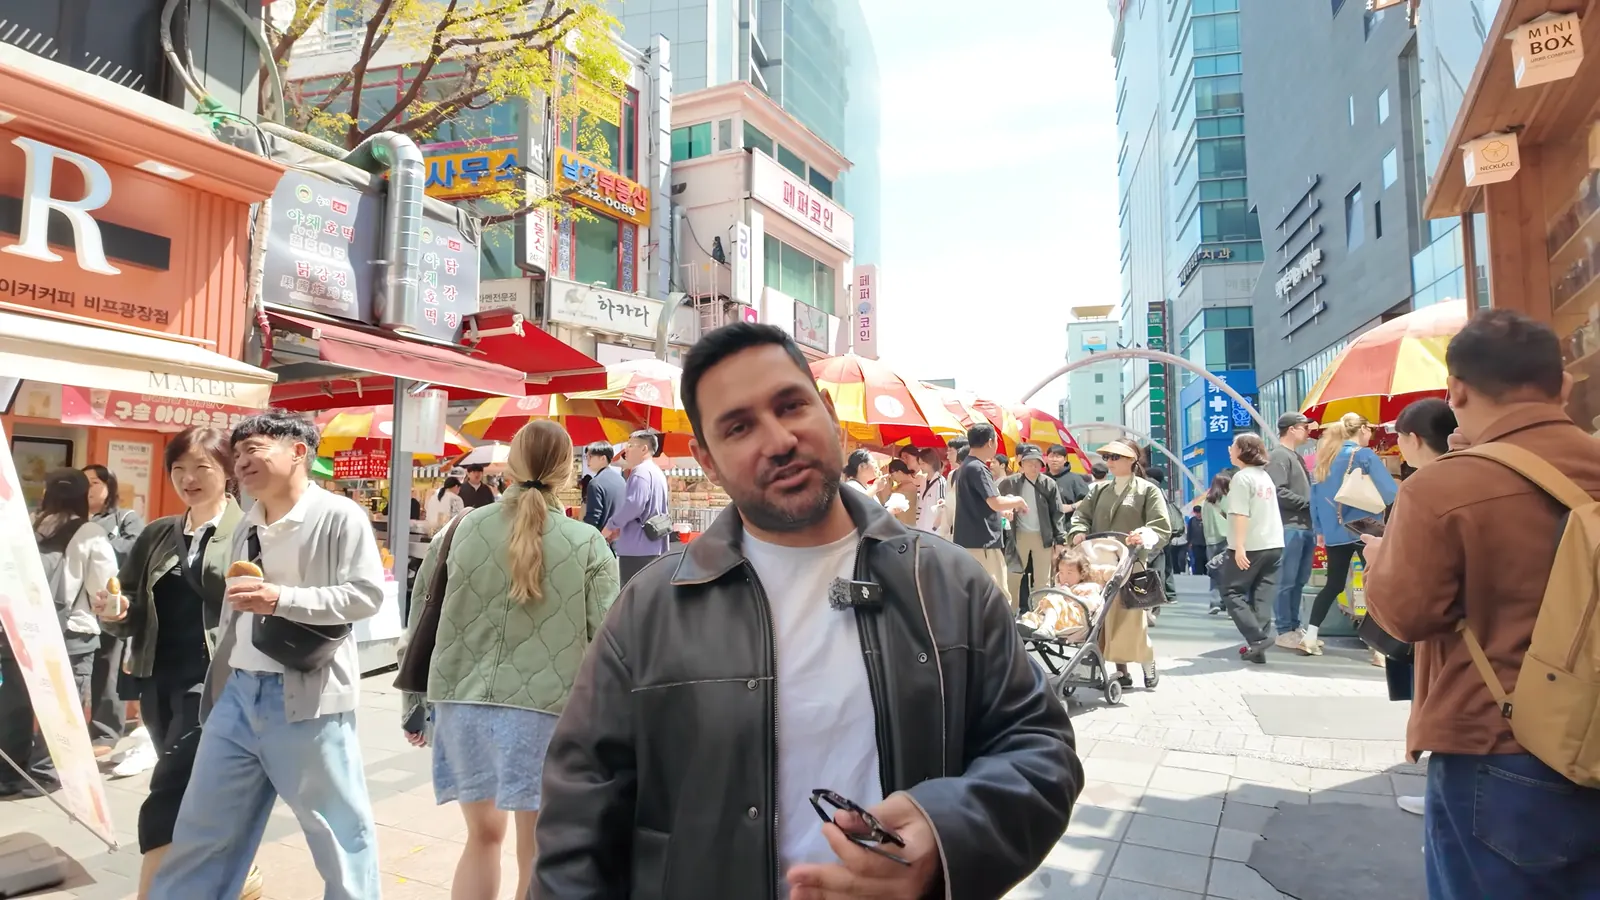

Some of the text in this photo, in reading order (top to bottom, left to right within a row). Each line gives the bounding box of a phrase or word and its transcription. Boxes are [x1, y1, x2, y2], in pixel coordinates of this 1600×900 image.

[1528, 21, 1572, 39] MINI
[1529, 34, 1575, 55] BOX
[530, 137, 544, 161] kt
[424, 153, 518, 189] 사무소
[1479, 161, 1515, 171] NECKLACE
[1, 136, 122, 275] R
[533, 179, 545, 254] 남부동산
[578, 188, 637, 216] 242-0089
[783, 181, 833, 232] 페퍼코인
[287, 208, 355, 243] 야채호떡
[739, 228, 748, 260] CU
[1202, 248, 1231, 260] 치과
[295, 260, 348, 288] 닭강정
[423, 252, 440, 325] 야채호떡
[0, 278, 169, 325] 이커커피 비프광장점
[444, 258, 459, 328] 닭강정
[859, 274, 870, 342] 페퍼 코인
[598, 294, 650, 328] 하카다
[148, 371, 236, 398] MAKER
[114, 400, 151, 421] 구슬
[1209, 415, 1229, 433] 药
